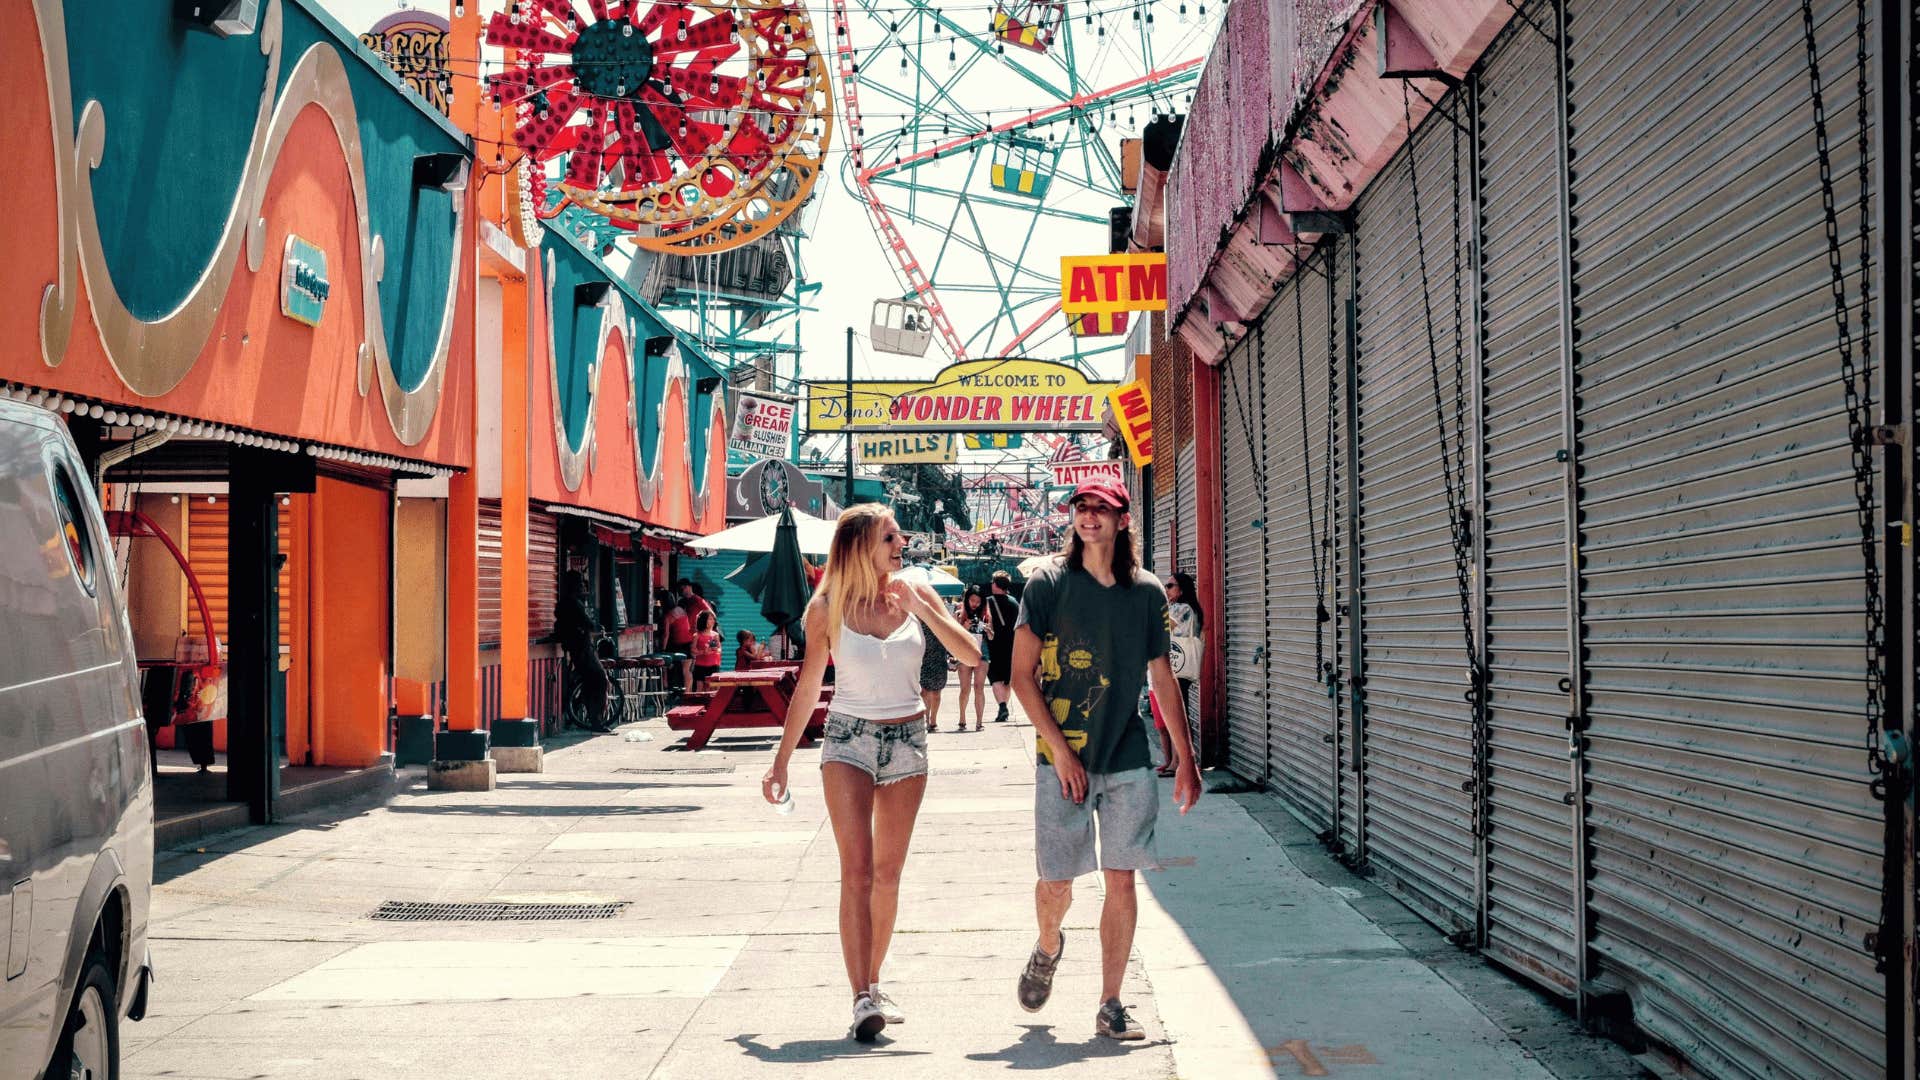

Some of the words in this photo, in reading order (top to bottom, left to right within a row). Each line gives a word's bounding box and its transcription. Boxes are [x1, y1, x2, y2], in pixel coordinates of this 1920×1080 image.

[1069, 264, 1167, 303] ATM
[958, 375, 1039, 388] WELCOME
[1044, 375, 1066, 388] TO
[760, 403, 791, 419] ICE
[890, 395, 1002, 421] WONDER
[1011, 395, 1095, 421] WHEEL
[744, 413, 790, 433] CREAM
[753, 430, 786, 444] SLUSHIES
[732, 439, 763, 454] ITALIAN
[765, 445, 784, 457] ICES
[861, 434, 953, 460] HRILLS!
